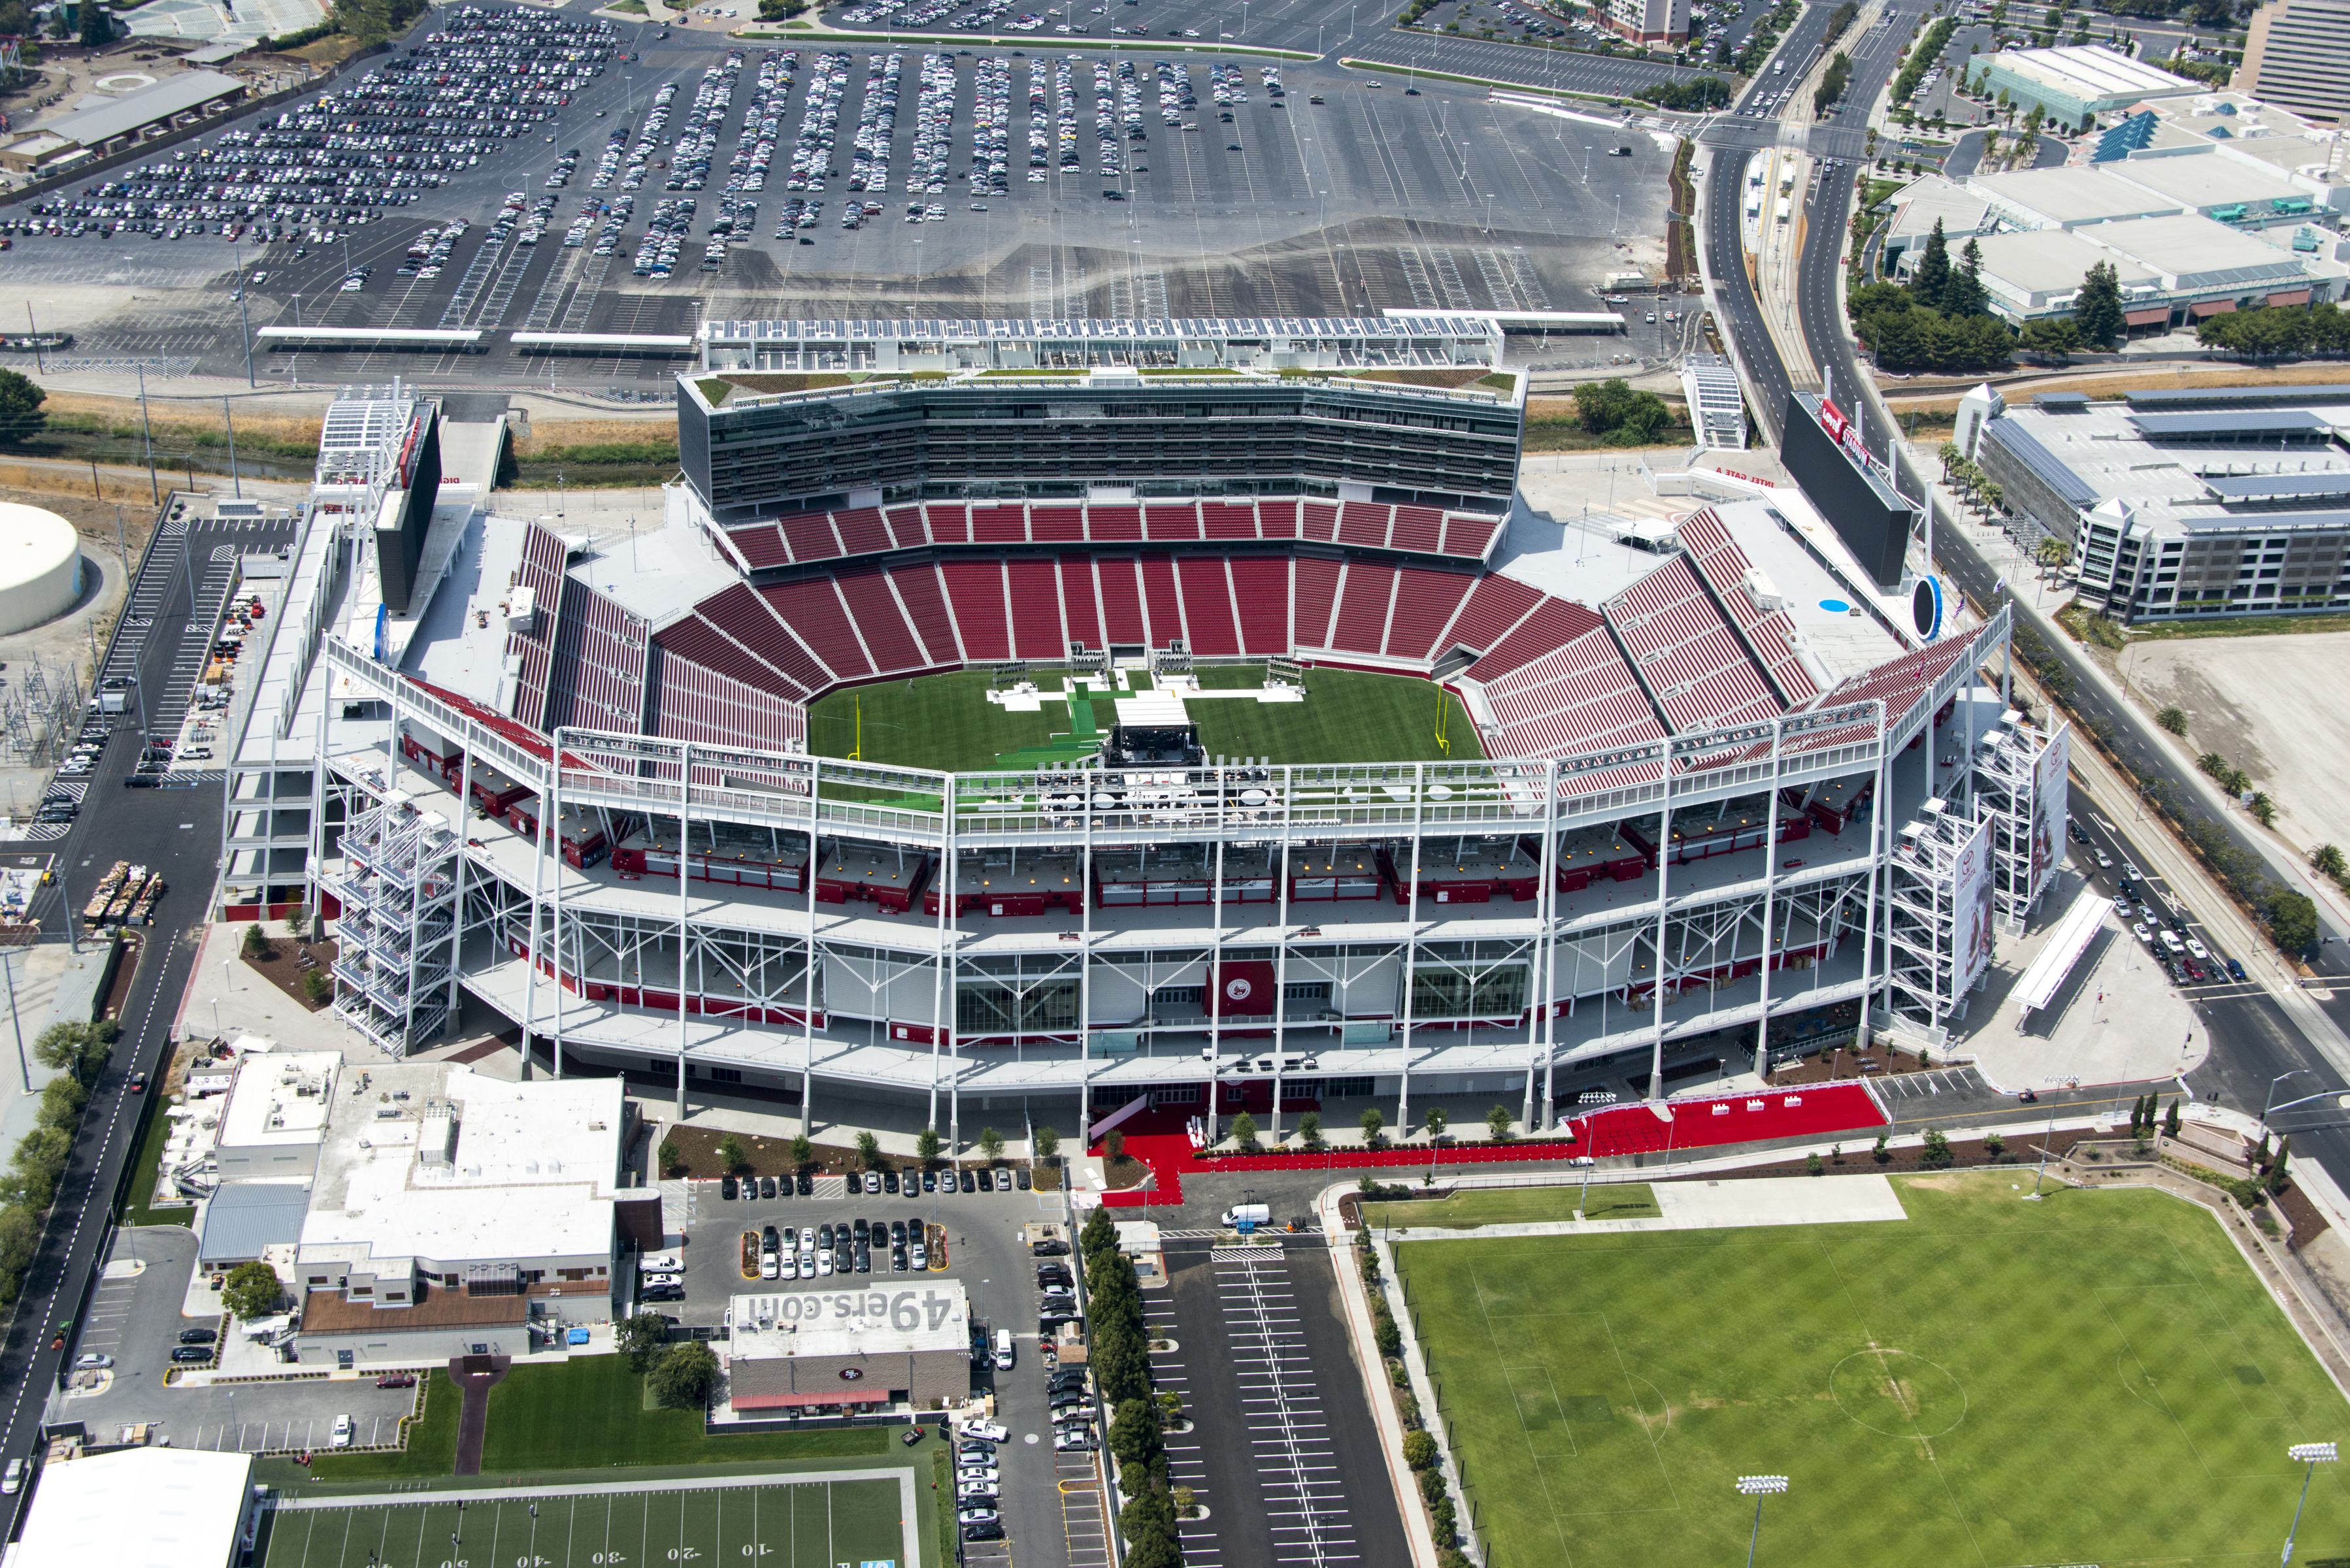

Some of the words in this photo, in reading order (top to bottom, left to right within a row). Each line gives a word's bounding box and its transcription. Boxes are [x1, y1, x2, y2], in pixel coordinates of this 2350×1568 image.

[1842, 430, 1868, 465] STADIUM
[2049, 759, 2062, 781] TOYOTA
[1959, 868, 1976, 891] TOYOTA
[748, 1290, 952, 1333] 49ers.com
[592, 1552, 620, 1565] 30
[667, 1547, 695, 1561] 20
[742, 1543, 767, 1556] 10
